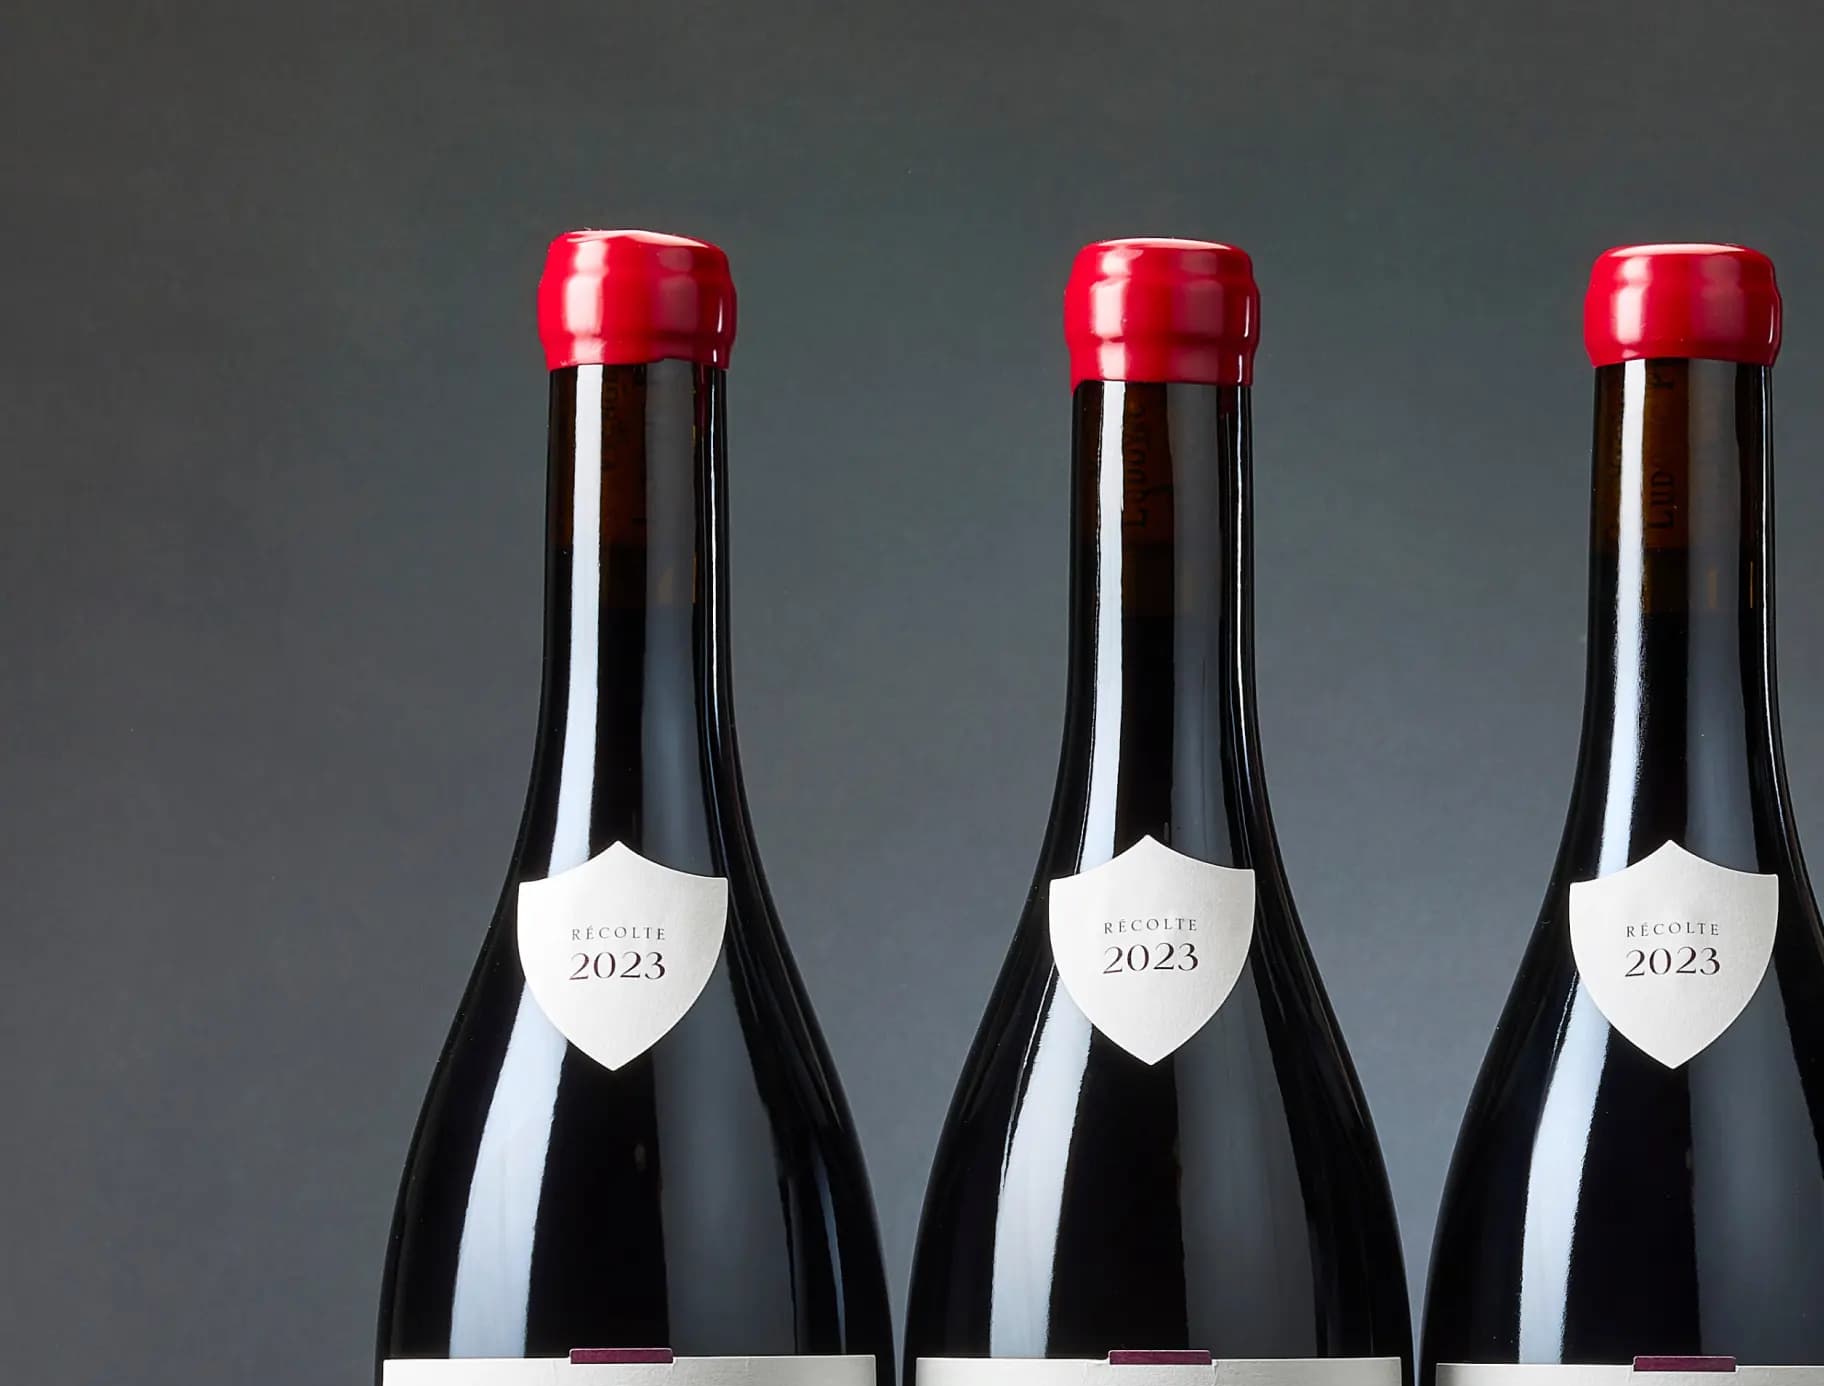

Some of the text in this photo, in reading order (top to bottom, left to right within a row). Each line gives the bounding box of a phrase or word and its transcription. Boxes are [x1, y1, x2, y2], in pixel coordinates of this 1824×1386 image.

[571, 925, 665, 941] RÉCOLTE
[1104, 917, 1197, 935] RÉCOLTE
[1626, 921, 1720, 938] RÉCOLTE
[569, 951, 666, 981] 2023
[1103, 942, 1199, 975] 2023
[1624, 946, 1721, 978] 2023
